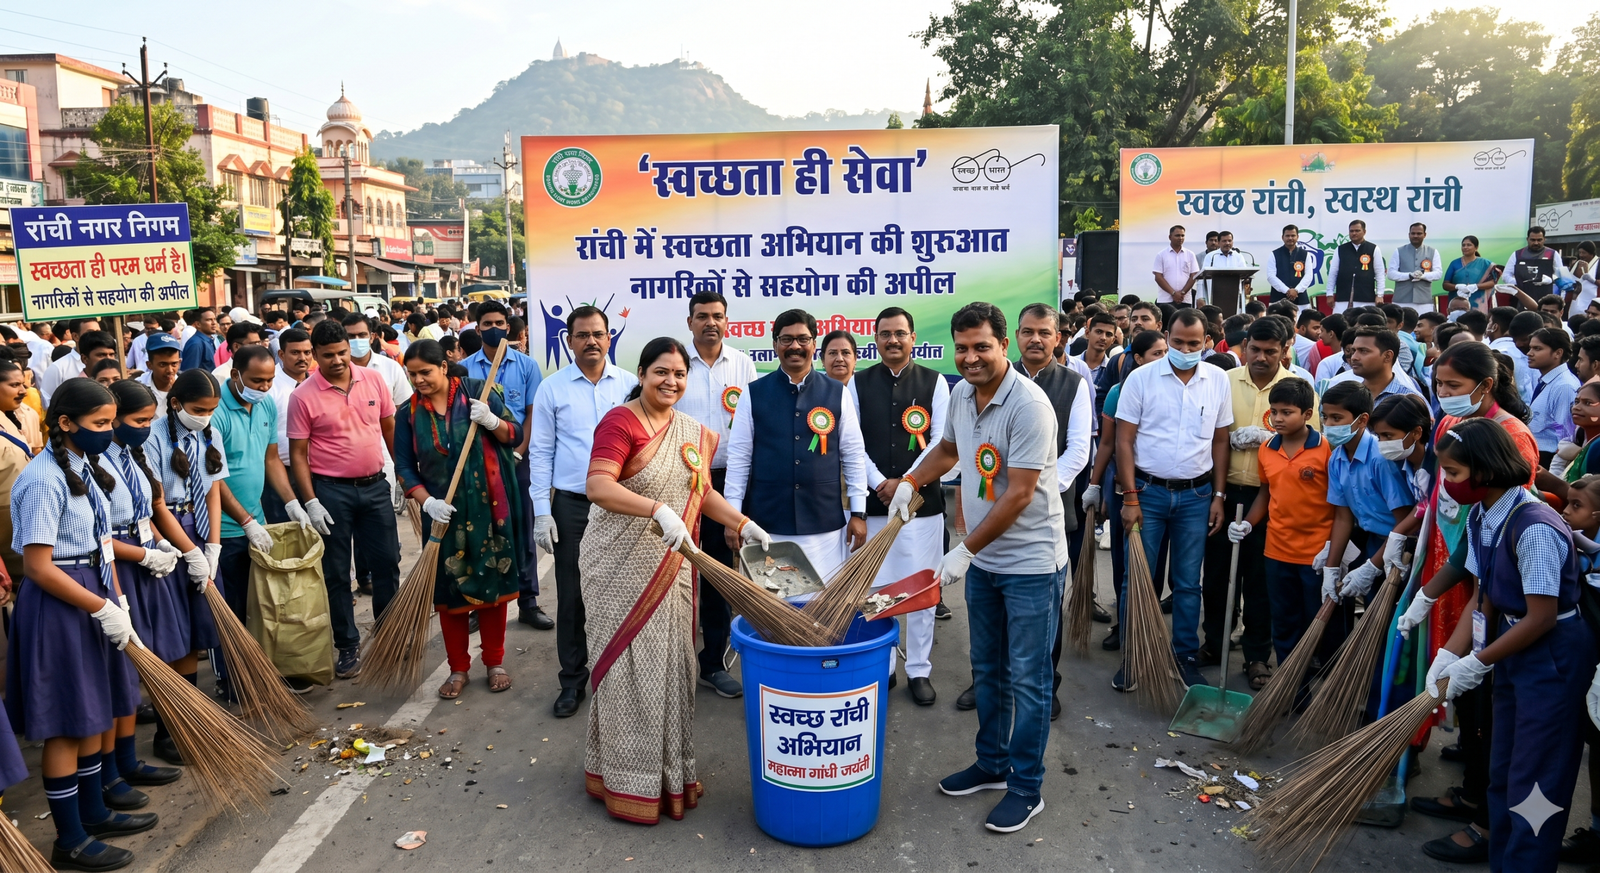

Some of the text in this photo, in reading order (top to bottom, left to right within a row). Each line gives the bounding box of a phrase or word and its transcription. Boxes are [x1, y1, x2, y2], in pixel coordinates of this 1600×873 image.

[793, 147, 833, 195] ही
[1176, 175, 1463, 219] स्वच्छ रांची, स्वस्थ रांची
[24, 210, 180, 242] रांची नगर निगम
[575, 223, 1010, 263] रांची में स्वच्छता अभियान की शुरुआत
[30, 260, 86, 282] स्वच्छता
[89, 251, 106, 279] ही
[109, 257, 141, 276] परम
[144, 248, 167, 275] धर्म
[31, 280, 190, 310] नागरिकों से सहयोग की अपील
[630, 265, 957, 300] नागरिकों से सहयोग की अपील
[768, 696, 870, 728] स्वच्छ रांची
[777, 731, 862, 757] अभियान
[767, 753, 870, 779] महात्मा गांधी जयंती
